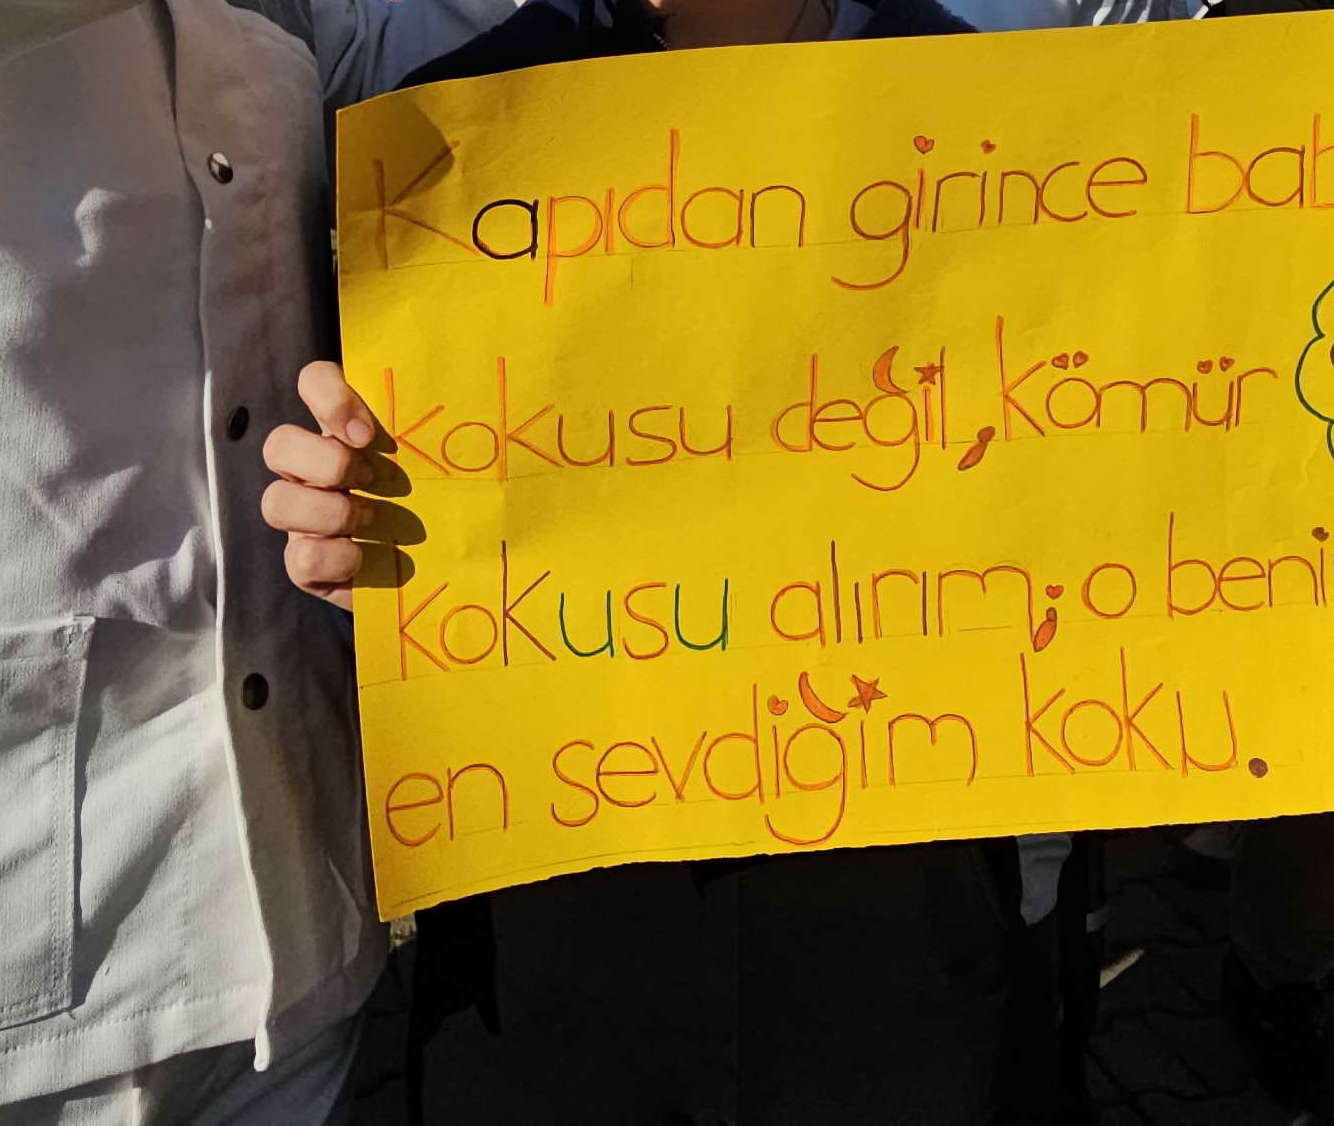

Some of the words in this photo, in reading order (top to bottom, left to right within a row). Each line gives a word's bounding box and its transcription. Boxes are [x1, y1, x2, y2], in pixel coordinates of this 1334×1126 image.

[374, 128, 806, 306] Kapıdan
[831, 135, 1148, 290] girince
[385, 356, 733, 482] kokusu
[995, 315, 1278, 441] kömür
[392, 539, 730, 681] kokusu
[1082, 563, 1137, 619] o
[385, 763, 510, 847] en
[551, 671, 978, 845] sevdiğim
[1020, 646, 1269, 778] koku.
